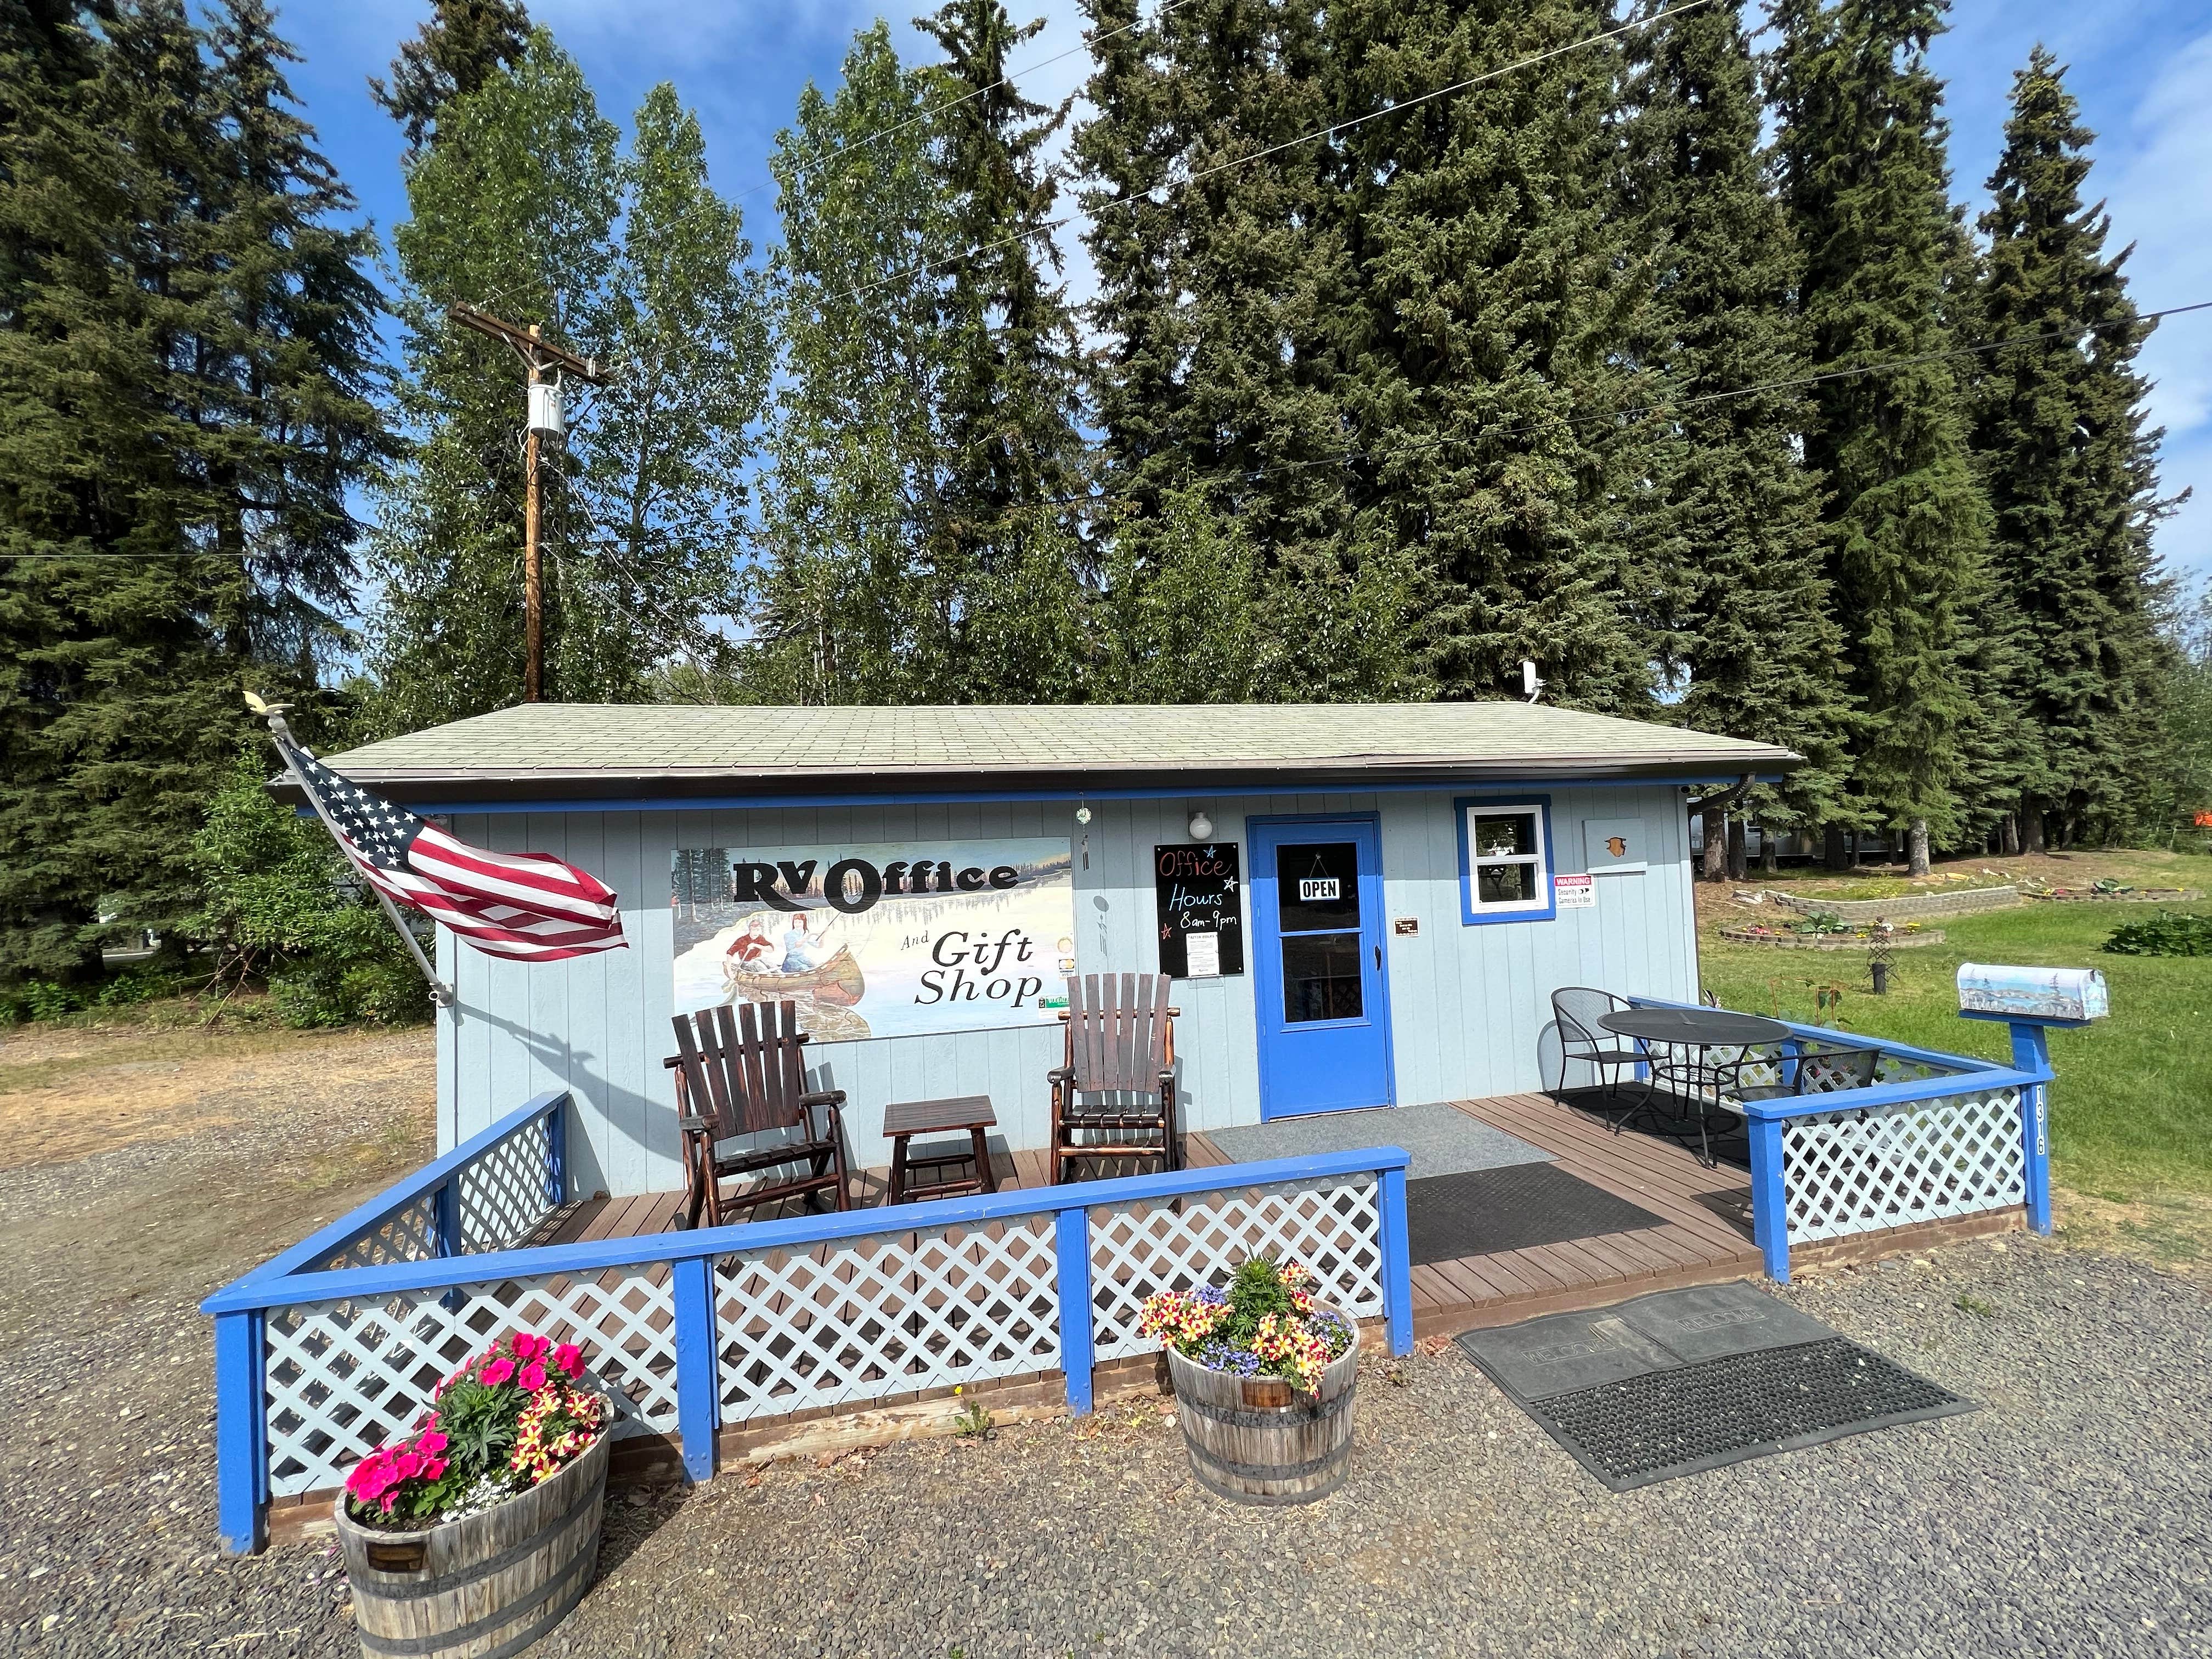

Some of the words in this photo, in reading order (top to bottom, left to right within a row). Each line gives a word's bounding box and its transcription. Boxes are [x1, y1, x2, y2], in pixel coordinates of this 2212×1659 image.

[1160, 850, 1232, 876] Office
[733, 860, 817, 912] RV
[824, 858, 1019, 913] Office
[1303, 881, 1336, 898] OPEN
[1556, 877, 1590, 885] WARNING
[1169, 883, 1223, 911] Hours
[901, 930, 929, 950] And
[933, 929, 1033, 975] Gift
[915, 969, 1042, 1008] Shop
[1675, 1307, 1765, 1331] WELCOME
[1521, 1339, 1616, 1364] WELCOME
